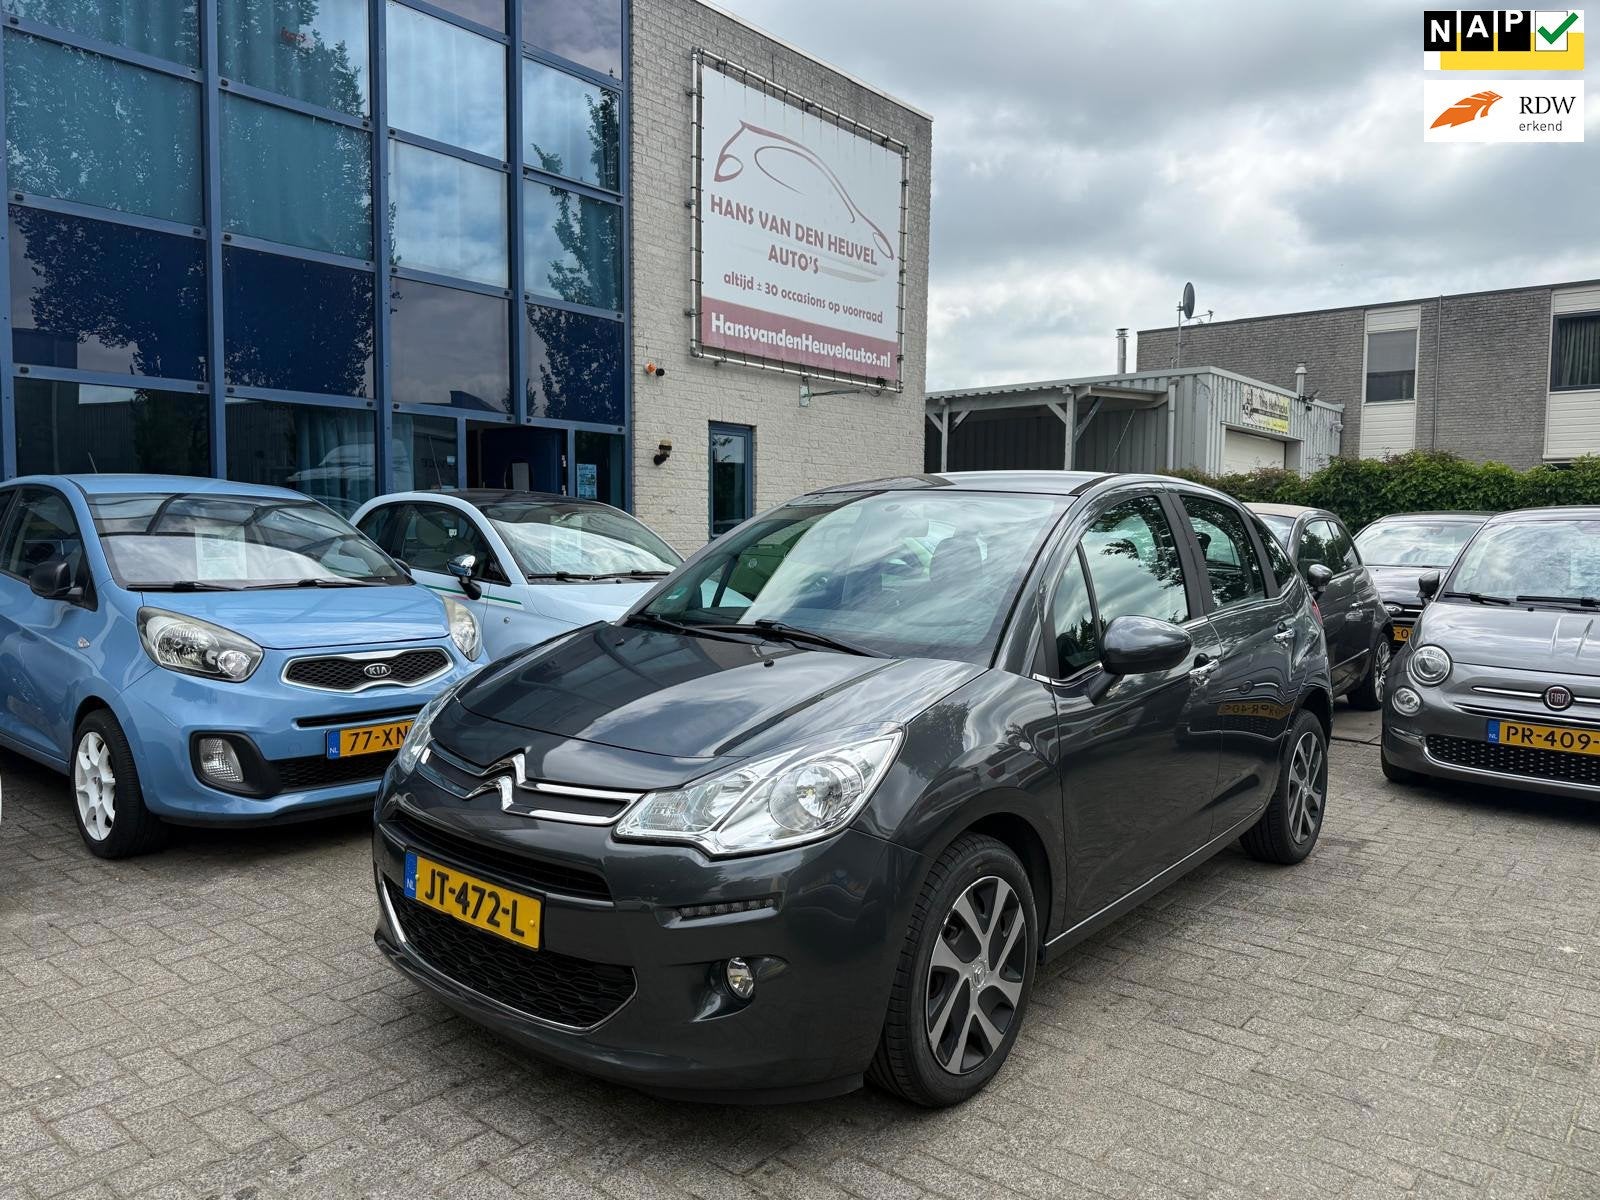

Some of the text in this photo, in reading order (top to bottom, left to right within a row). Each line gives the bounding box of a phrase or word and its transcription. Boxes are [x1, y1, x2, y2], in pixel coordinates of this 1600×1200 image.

[710, 194, 878, 265] HANS VAN DEN HEUVEL
[768, 244, 819, 274] AUTO'S
[723, 271, 754, 291] altijd
[764, 282, 778, 297] 30
[781, 289, 826, 309] occasions
[828, 301, 840, 313] op
[842, 304, 883, 324] voorraad
[711, 312, 891, 368] HansvandenHeuvelautos.nl
[368, 666, 388, 675] KIA
[1550, 692, 1566, 704] FIAT
[406, 868, 525, 938] NL JT-472-L
